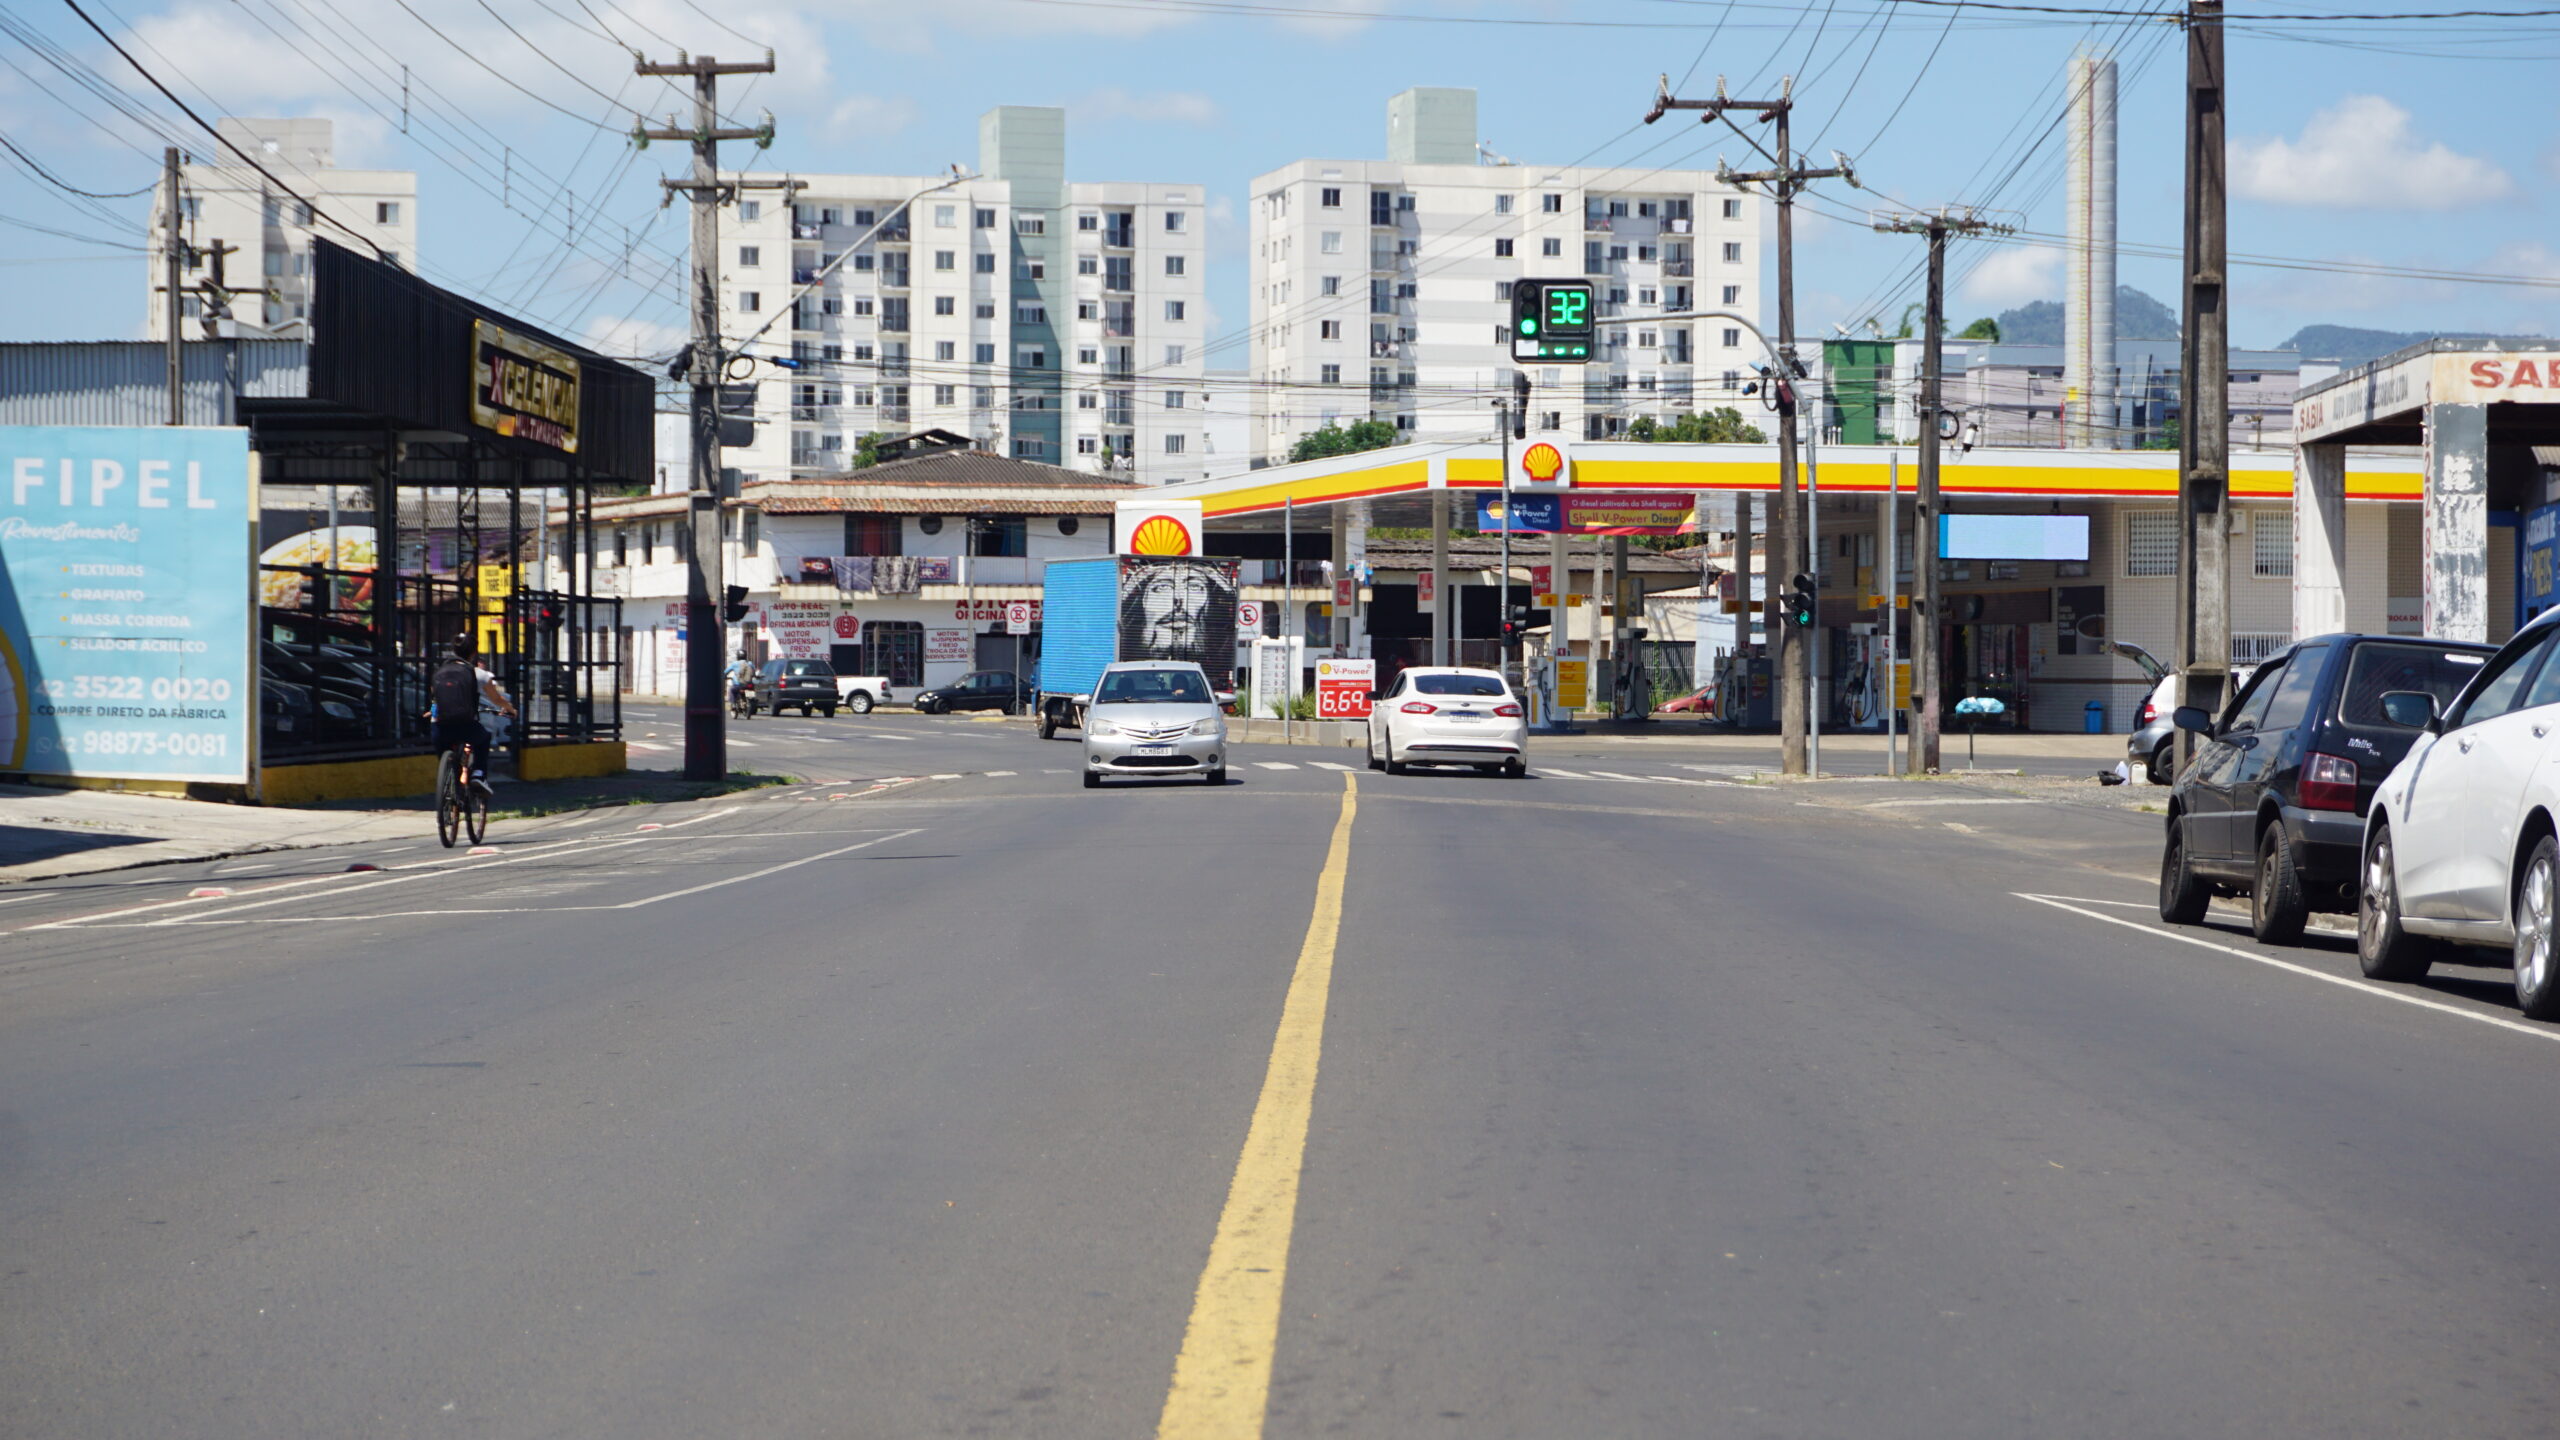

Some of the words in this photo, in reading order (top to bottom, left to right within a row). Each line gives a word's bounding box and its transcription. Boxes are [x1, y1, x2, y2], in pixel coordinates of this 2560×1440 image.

[1551, 292, 1586, 324] 32
[2300, 391, 2324, 433] SABIÁ
[13, 457, 216, 509] FIPEL
[1579, 499, 1598, 507] diesel
[1600, 499, 1630, 508] aditivado
[1641, 499, 1657, 507] Shell
[1658, 501, 1677, 509] agora
[1513, 509, 1549, 518] V-Power
[1572, 512, 1600, 523] Shell
[1602, 512, 1648, 523] V-Power
[1651, 512, 1683, 523] Diesel
[0, 516, 141, 543] Revestimentos
[71, 563, 145, 577] TEXTURAS
[71, 588, 145, 601] GRAFIATO
[773, 602, 797, 611] AUTO
[801, 602, 825, 611] REAL
[70, 613, 121, 627] MASSA
[125, 614, 192, 628] CORRIDA
[782, 611, 805, 619] 3522
[956, 610, 1006, 620] OFICINA
[769, 620, 796, 628] OFICINA
[70, 639, 137, 651] SELADOR
[1333, 667, 1370, 675] V-Power
[36, 680, 66, 698] 42
[72, 675, 144, 700] 3522
[151, 678, 232, 701] 0020
[38, 704, 92, 717] COMPRE
[97, 706, 144, 718] DIRETO
[149, 707, 167, 718] DA
[55, 737, 77, 752] 42
[83, 731, 227, 757] 98873-0081
[2347, 737, 2373, 749] Mille
